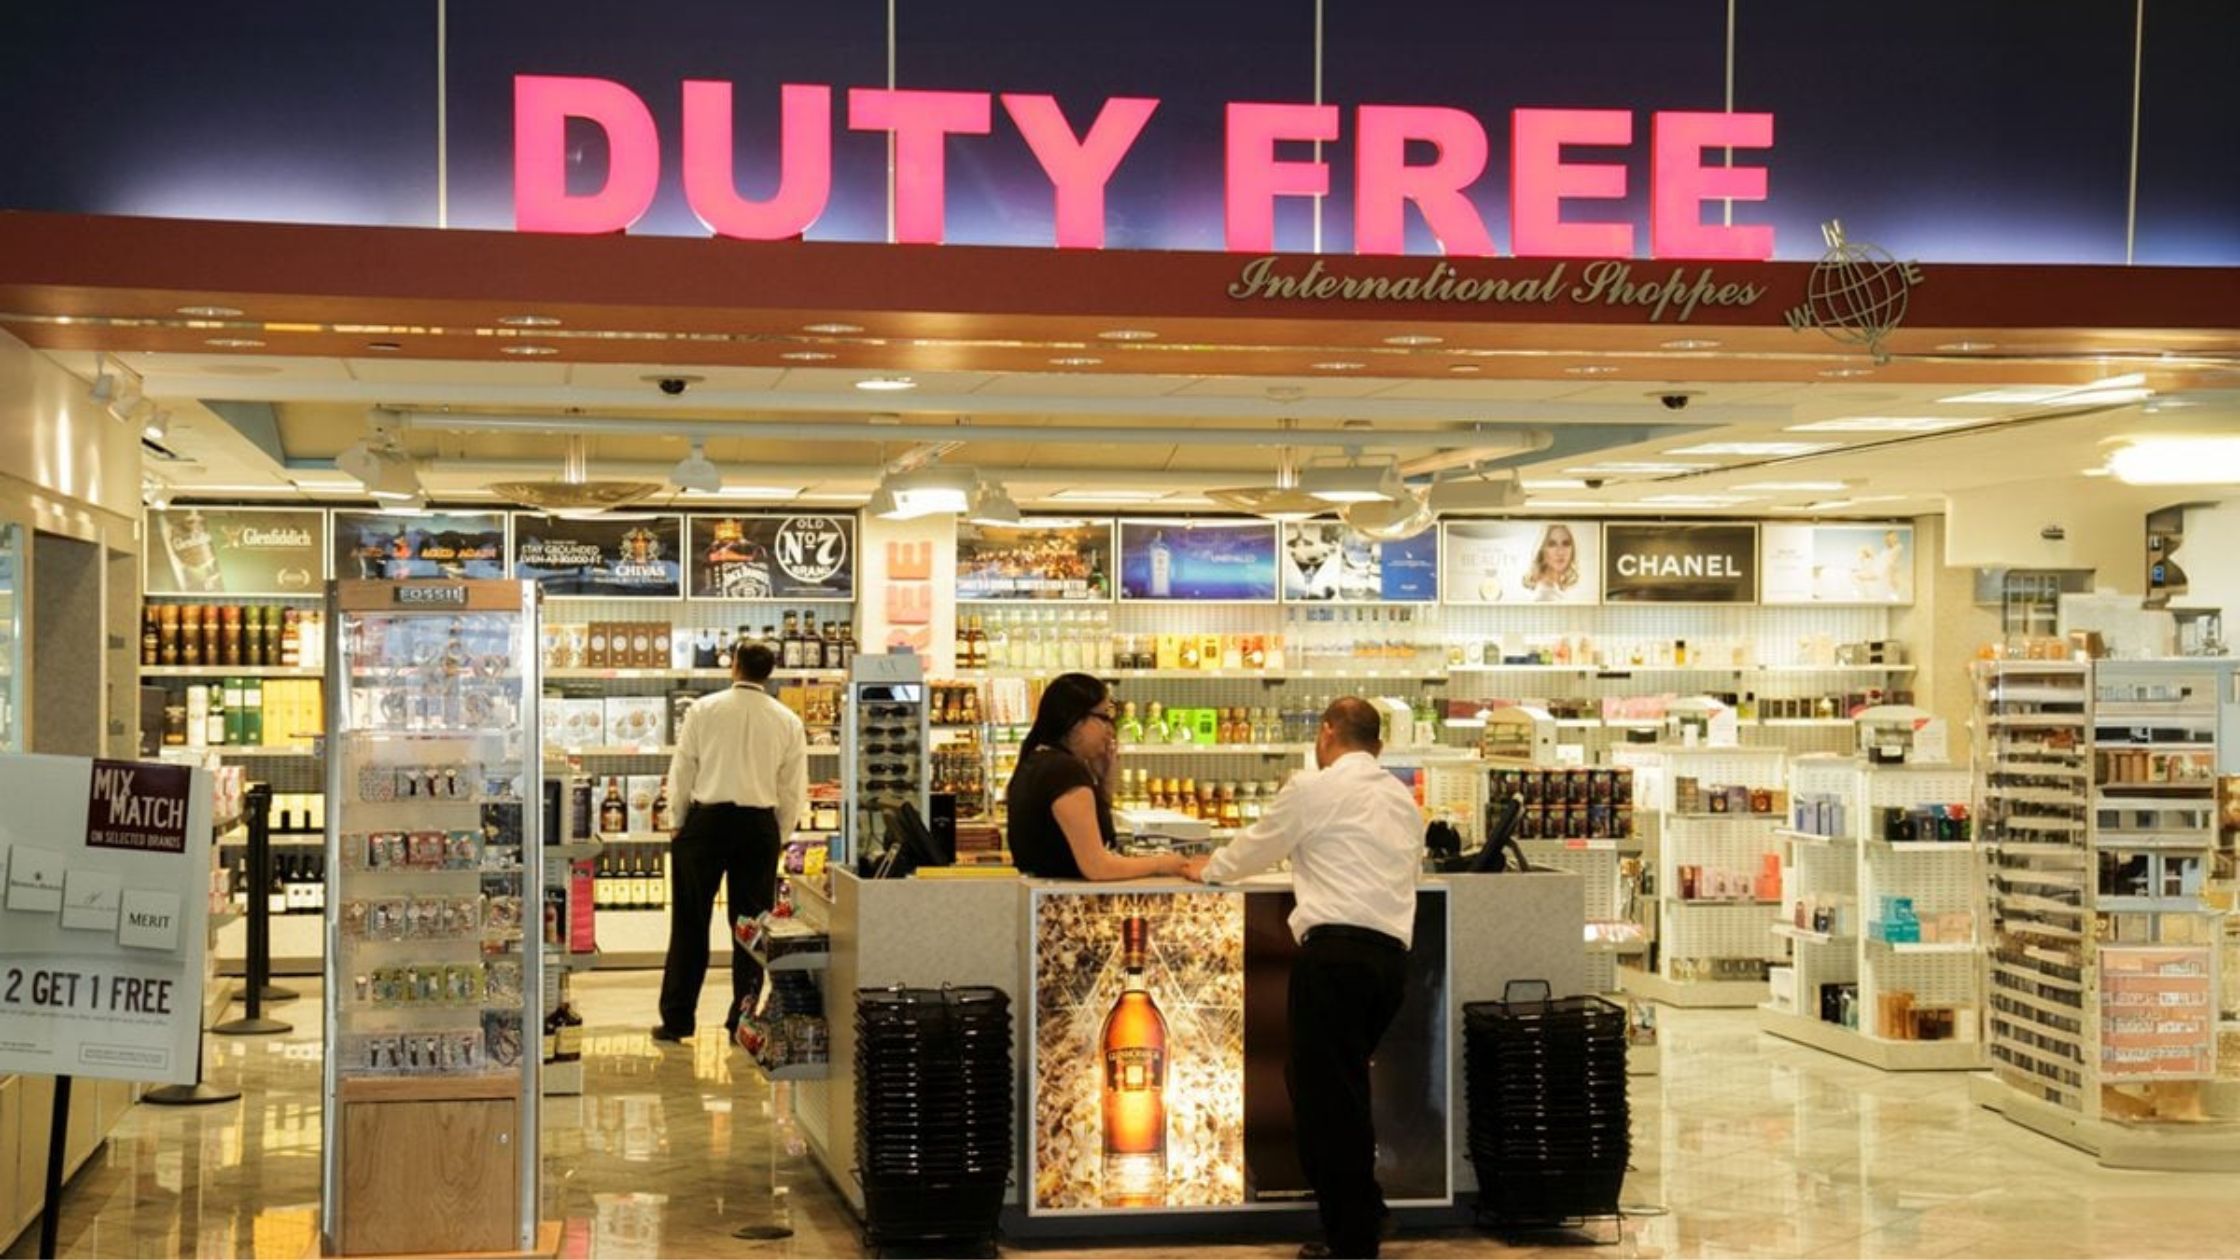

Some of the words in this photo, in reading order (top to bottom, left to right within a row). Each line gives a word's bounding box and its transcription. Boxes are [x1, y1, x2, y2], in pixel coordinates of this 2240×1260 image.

[514, 74, 1160, 249] DUTY
[1224, 102, 1775, 260] FREE
[1228, 256, 1567, 302] International
[1571, 259, 1768, 322] Shoppes
[796, 517, 825, 530] OLD
[242, 528, 312, 547] Glenfiddich
[615, 565, 667, 577] CHIVAS
[1617, 554, 1742, 577] CHANEL
[93, 768, 135, 800] MIX
[109, 795, 185, 829] MATCH
[105, 831, 145, 845] SELECTED
[146, 834, 181, 849] BRANDS
[129, 912, 170, 929] MERIT
[5, 968, 23, 1003] 2
[32, 970, 81, 1007] GET
[91, 975, 99, 1009] 1
[110, 976, 173, 1015] FREE
